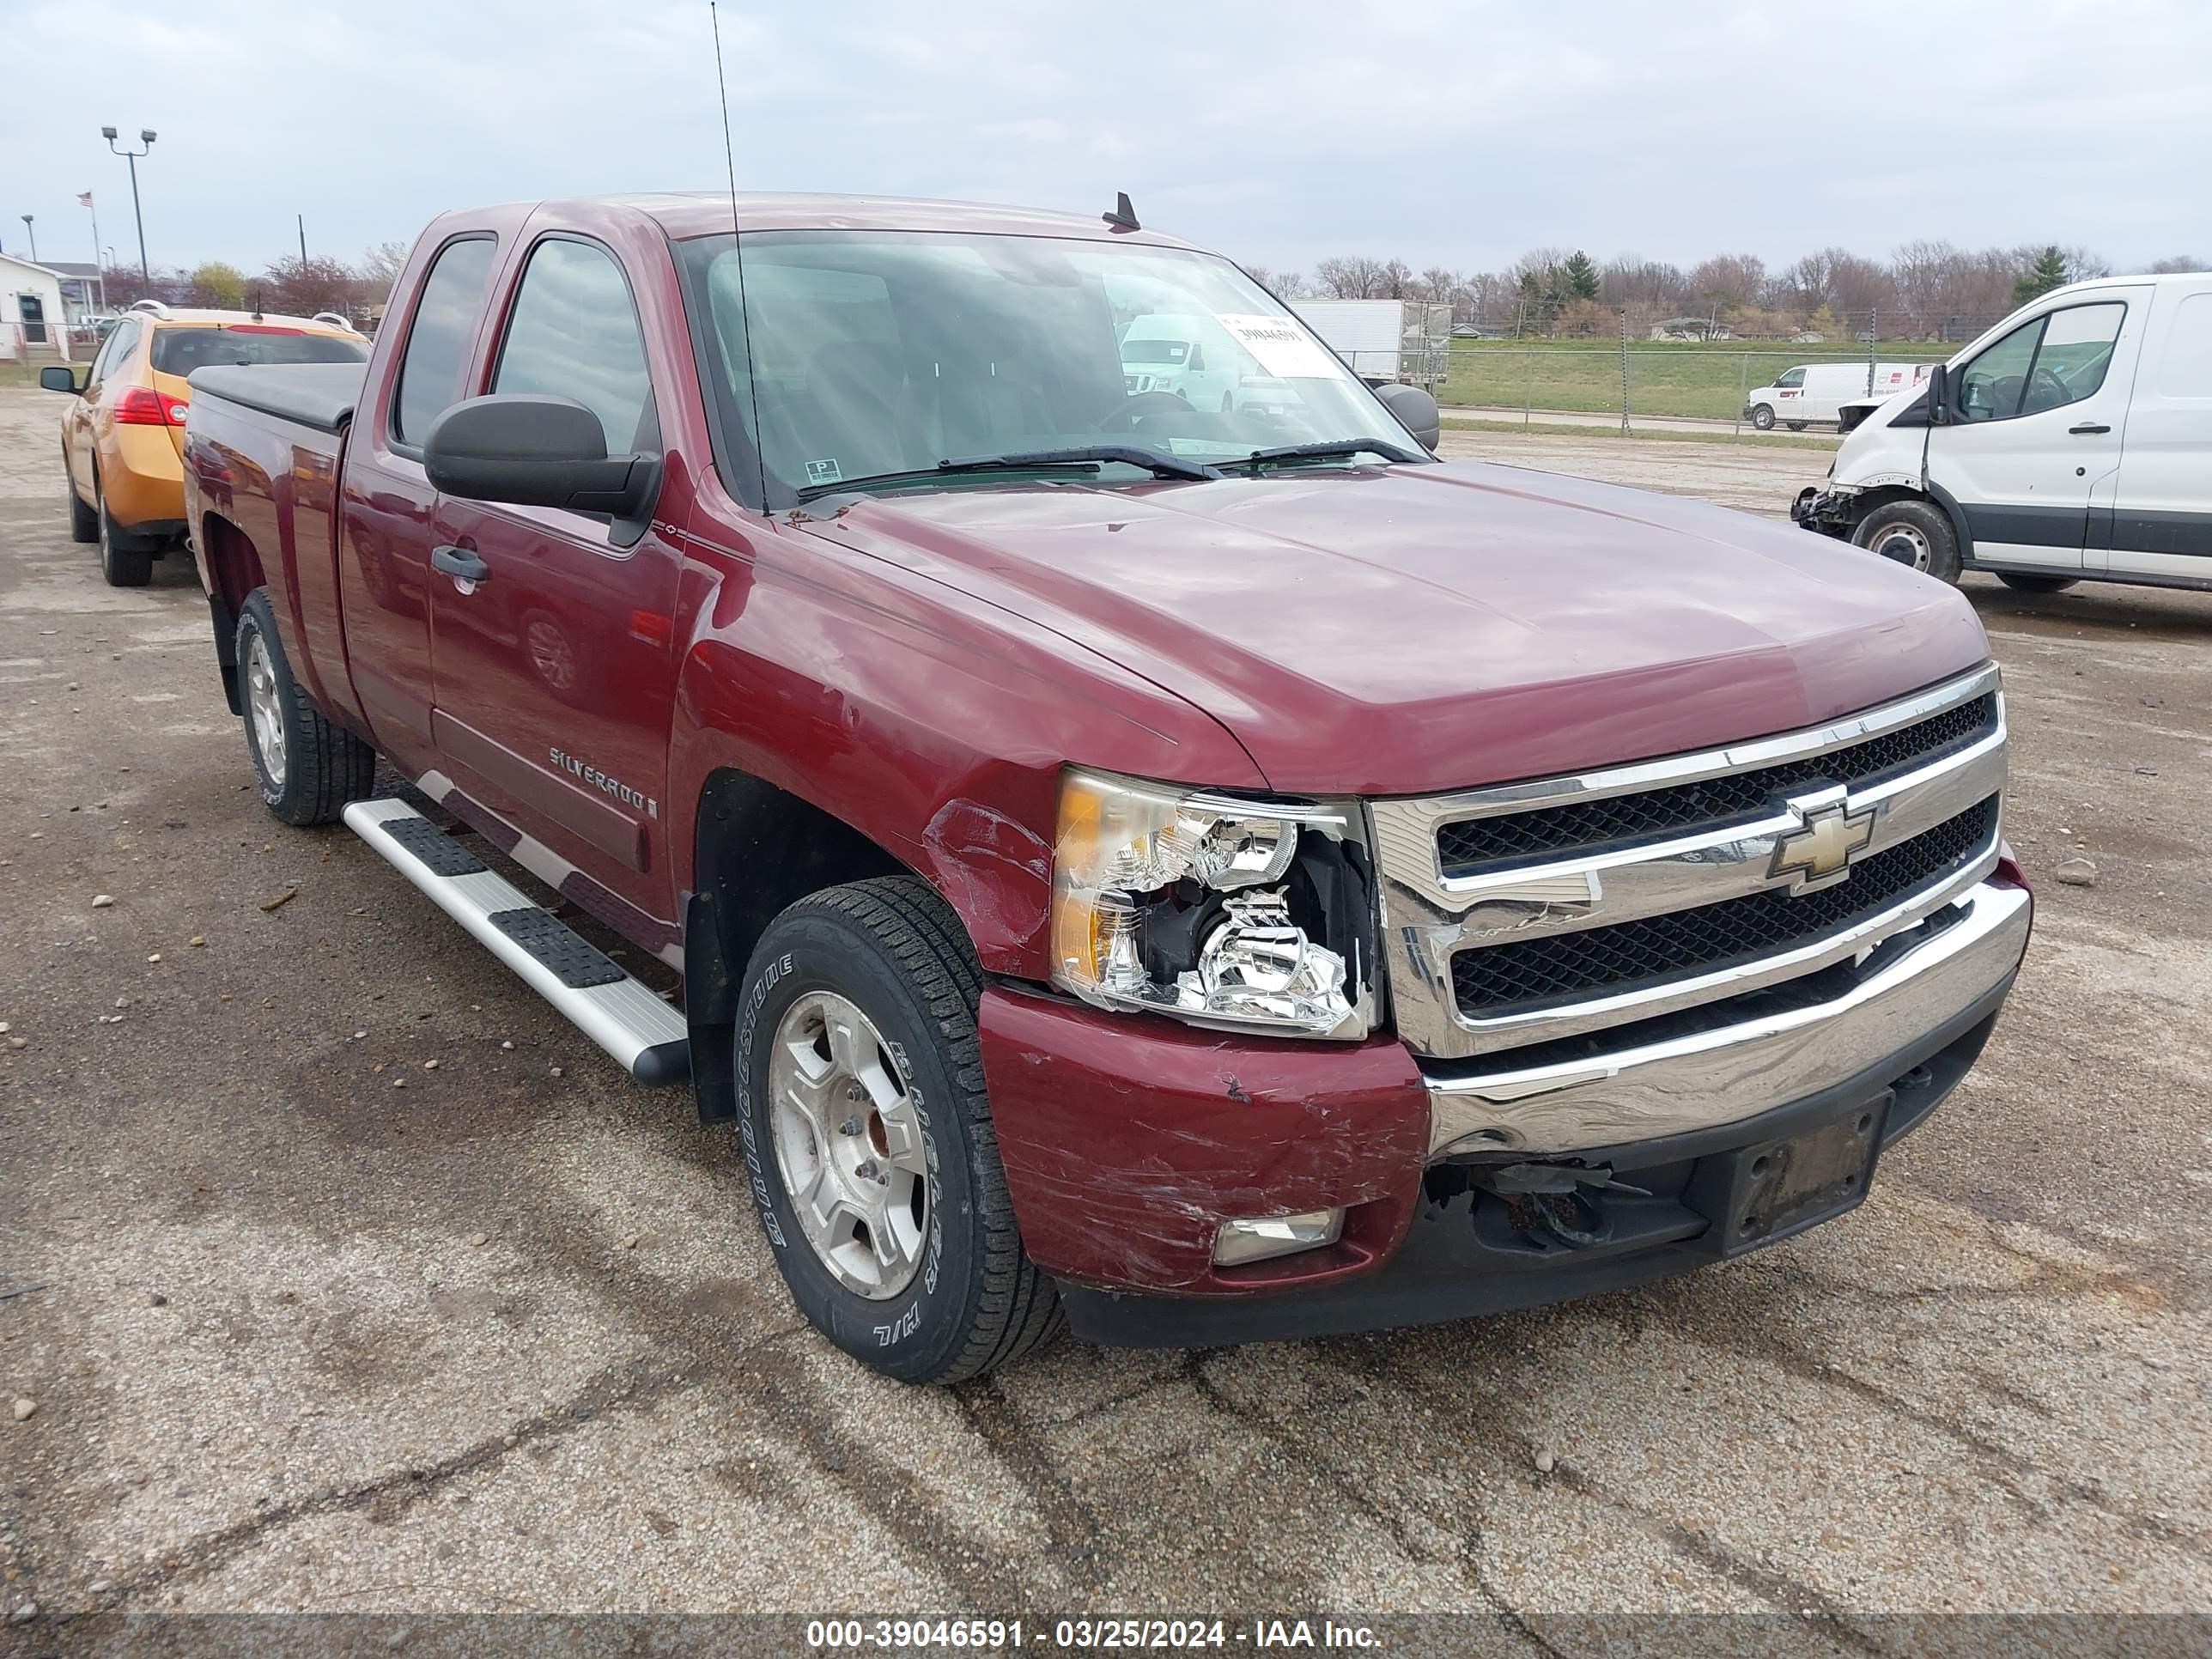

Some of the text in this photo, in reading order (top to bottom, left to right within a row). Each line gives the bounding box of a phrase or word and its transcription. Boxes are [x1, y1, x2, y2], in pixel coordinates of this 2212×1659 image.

[1237, 329, 1303, 342] 39046591
[816, 463, 828, 473] P
[550, 747, 643, 810] SILVERADO
[738, 953, 792, 1248] BRIDGESTONE
[873, 1041, 943, 1346] DUELER H/L
